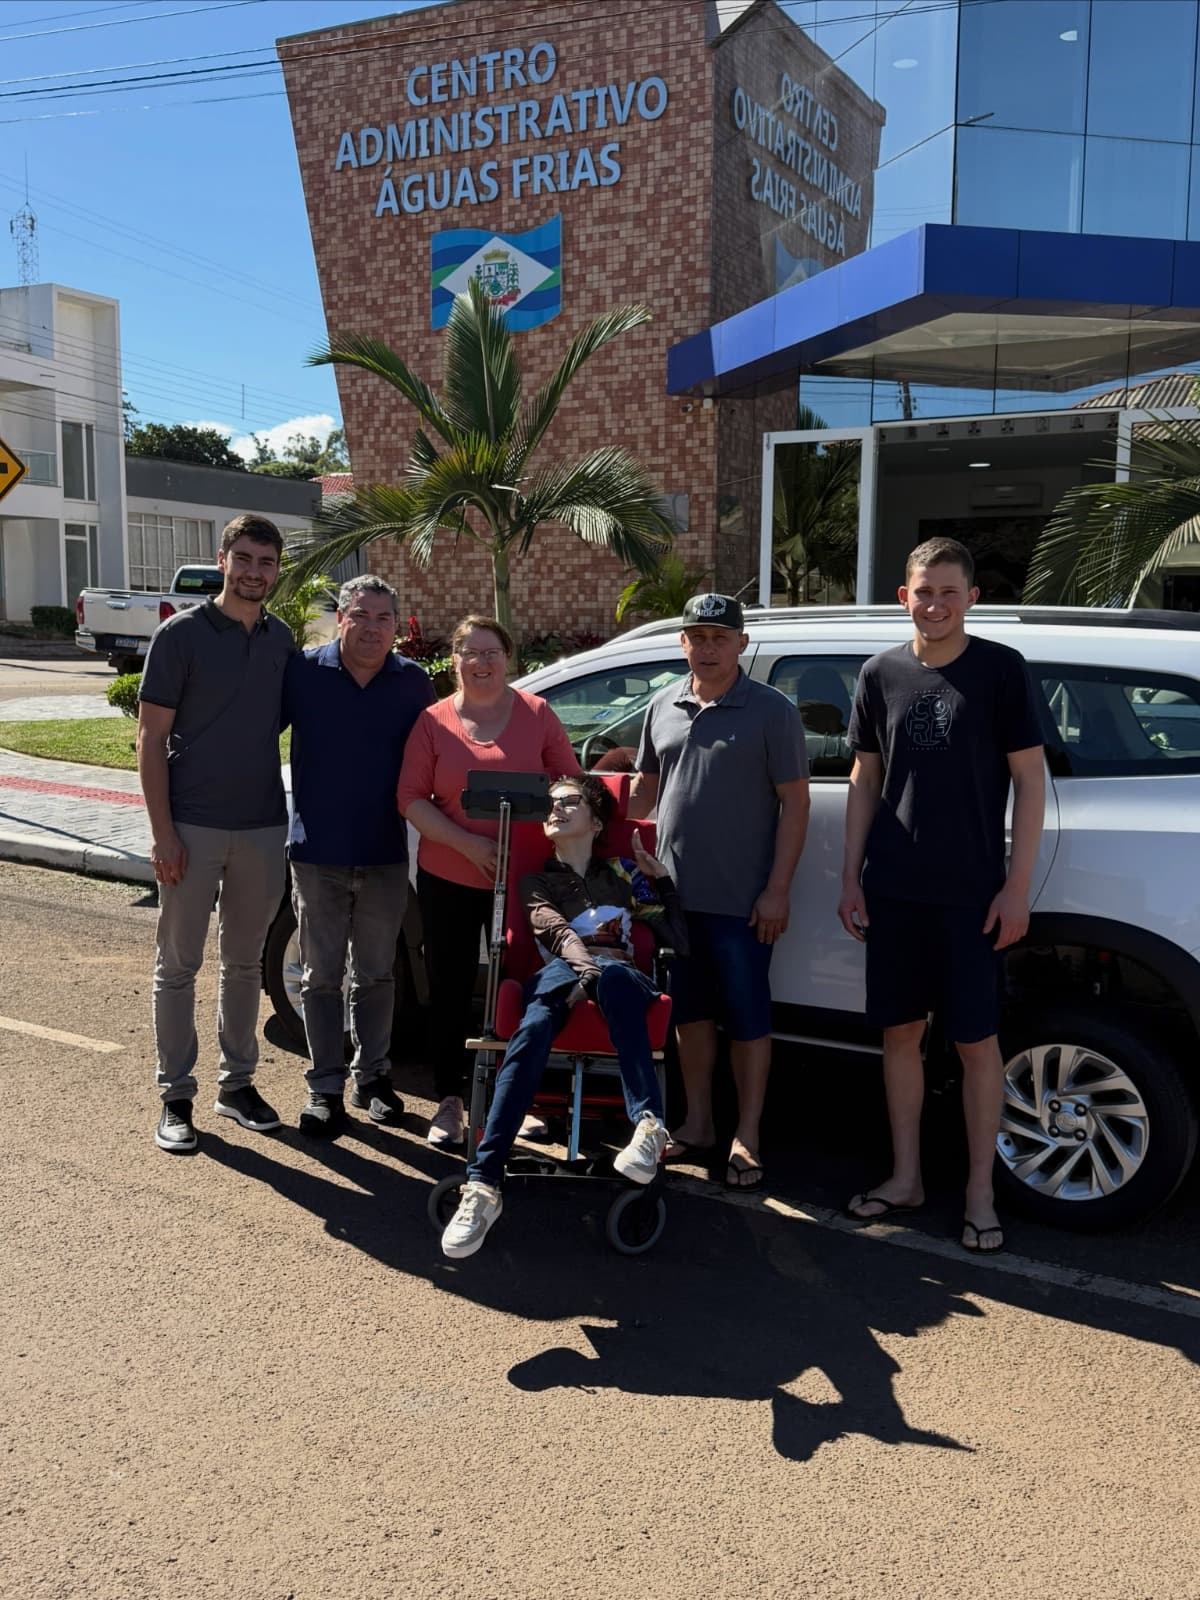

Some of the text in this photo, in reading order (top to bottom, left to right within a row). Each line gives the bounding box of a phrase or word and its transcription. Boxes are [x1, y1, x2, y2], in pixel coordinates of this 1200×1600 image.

[407, 42, 557, 107] CENTRO
[335, 76, 668, 171] ADMINISTRATIVO
[375, 142, 621, 218] ÁGUAS FRIAS
